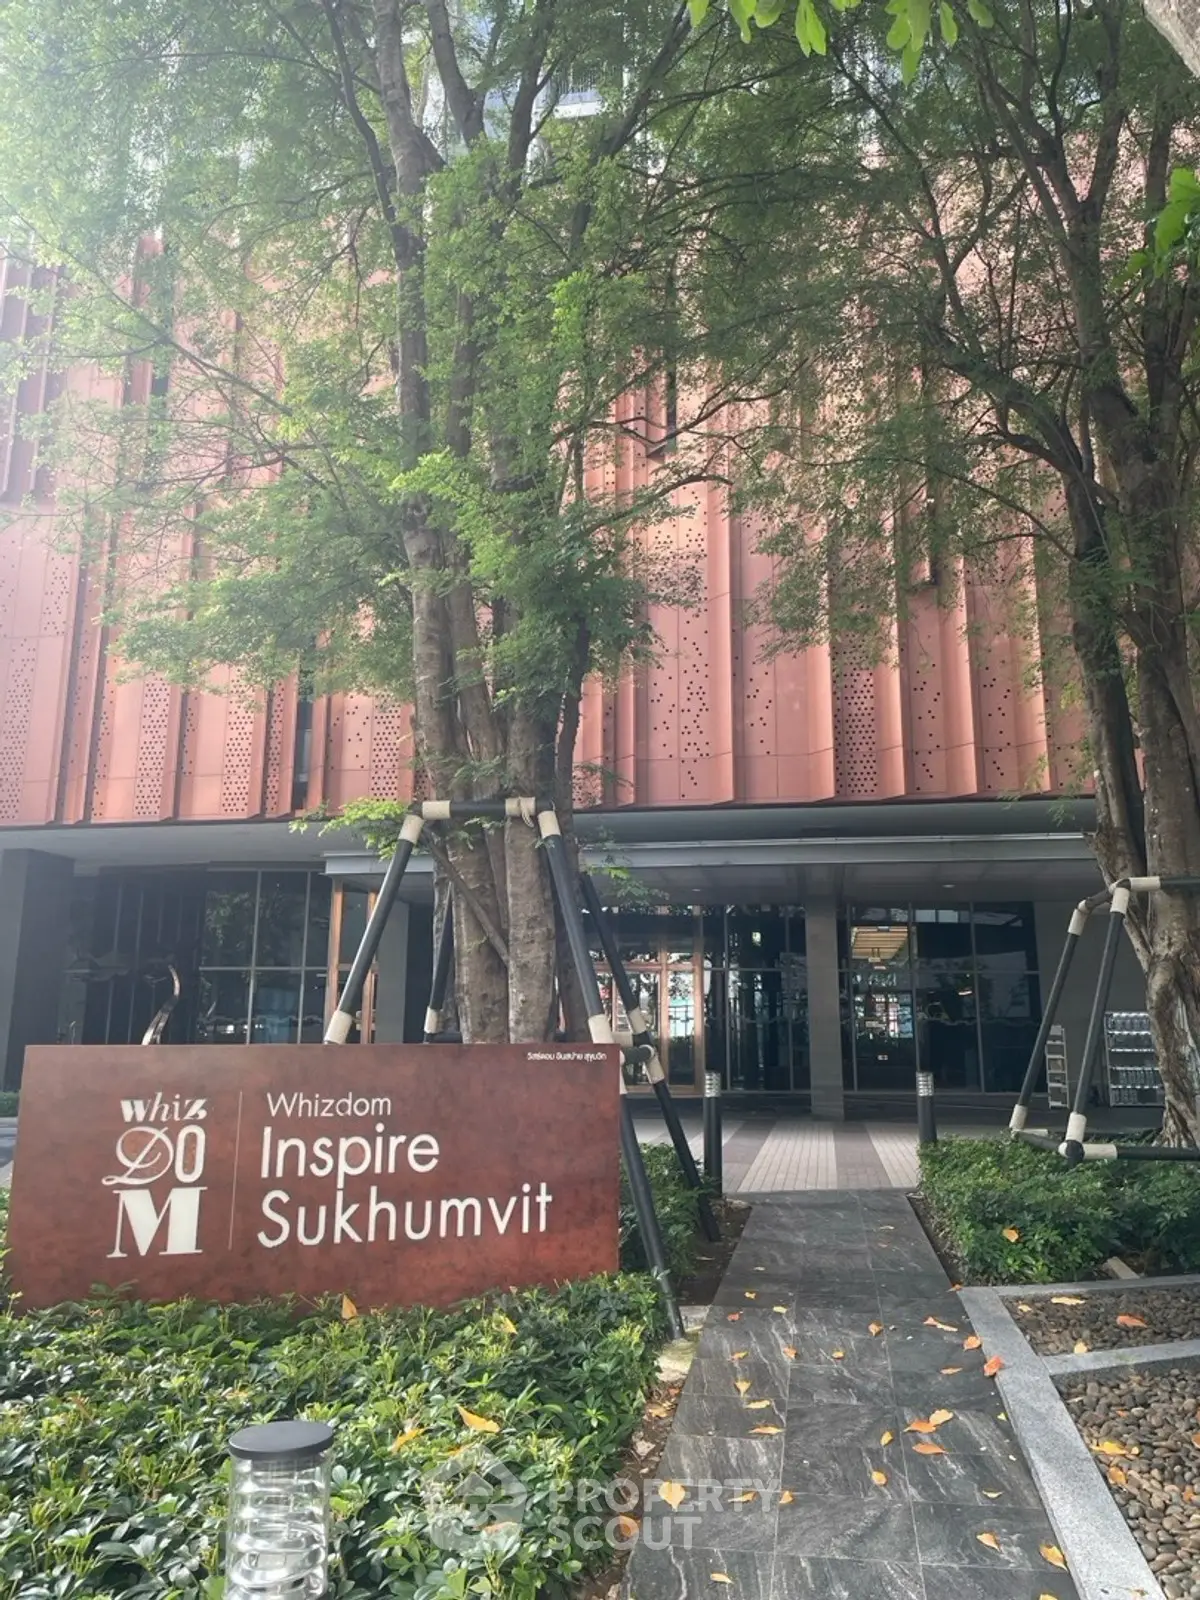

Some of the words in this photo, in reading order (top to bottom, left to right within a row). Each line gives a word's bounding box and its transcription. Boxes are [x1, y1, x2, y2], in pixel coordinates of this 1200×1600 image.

[266, 1091, 391, 1118] Whizdom
[260, 1122, 440, 1189] Inspire
[257, 1182, 553, 1248] Sukhumvit
